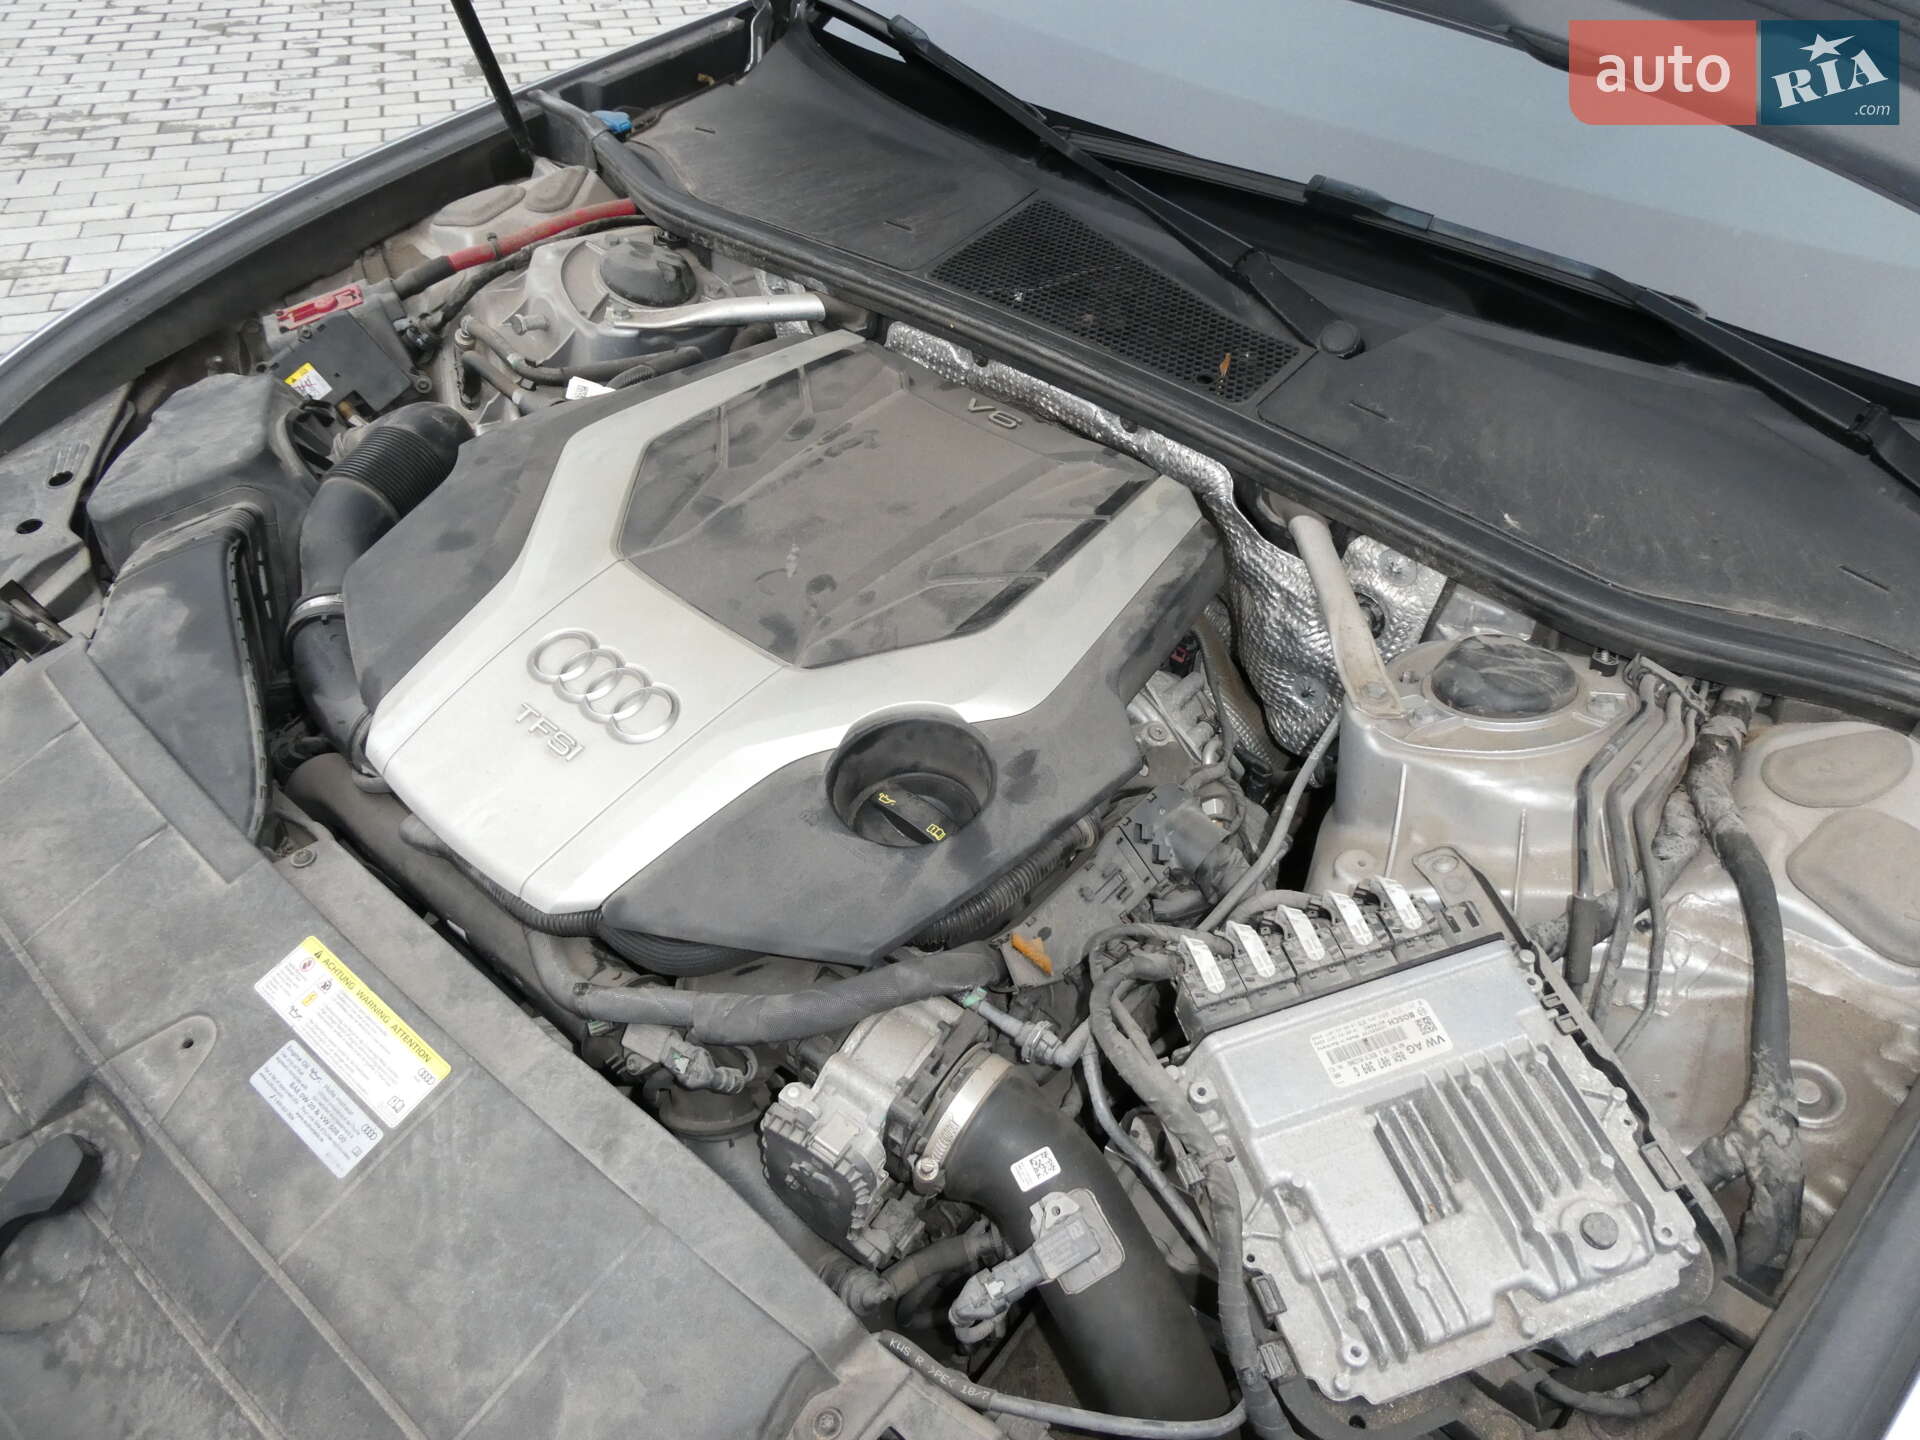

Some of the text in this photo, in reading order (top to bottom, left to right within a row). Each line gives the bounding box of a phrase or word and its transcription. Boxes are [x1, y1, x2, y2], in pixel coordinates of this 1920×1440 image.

[968, 397, 1023, 430] V6
[322, 958, 355, 990] ACHTUNG
[355, 989, 391, 1025] WARNING
[391, 1024, 432, 1063] ATTENTION
[1404, 1033, 1445, 1055] VW AG
